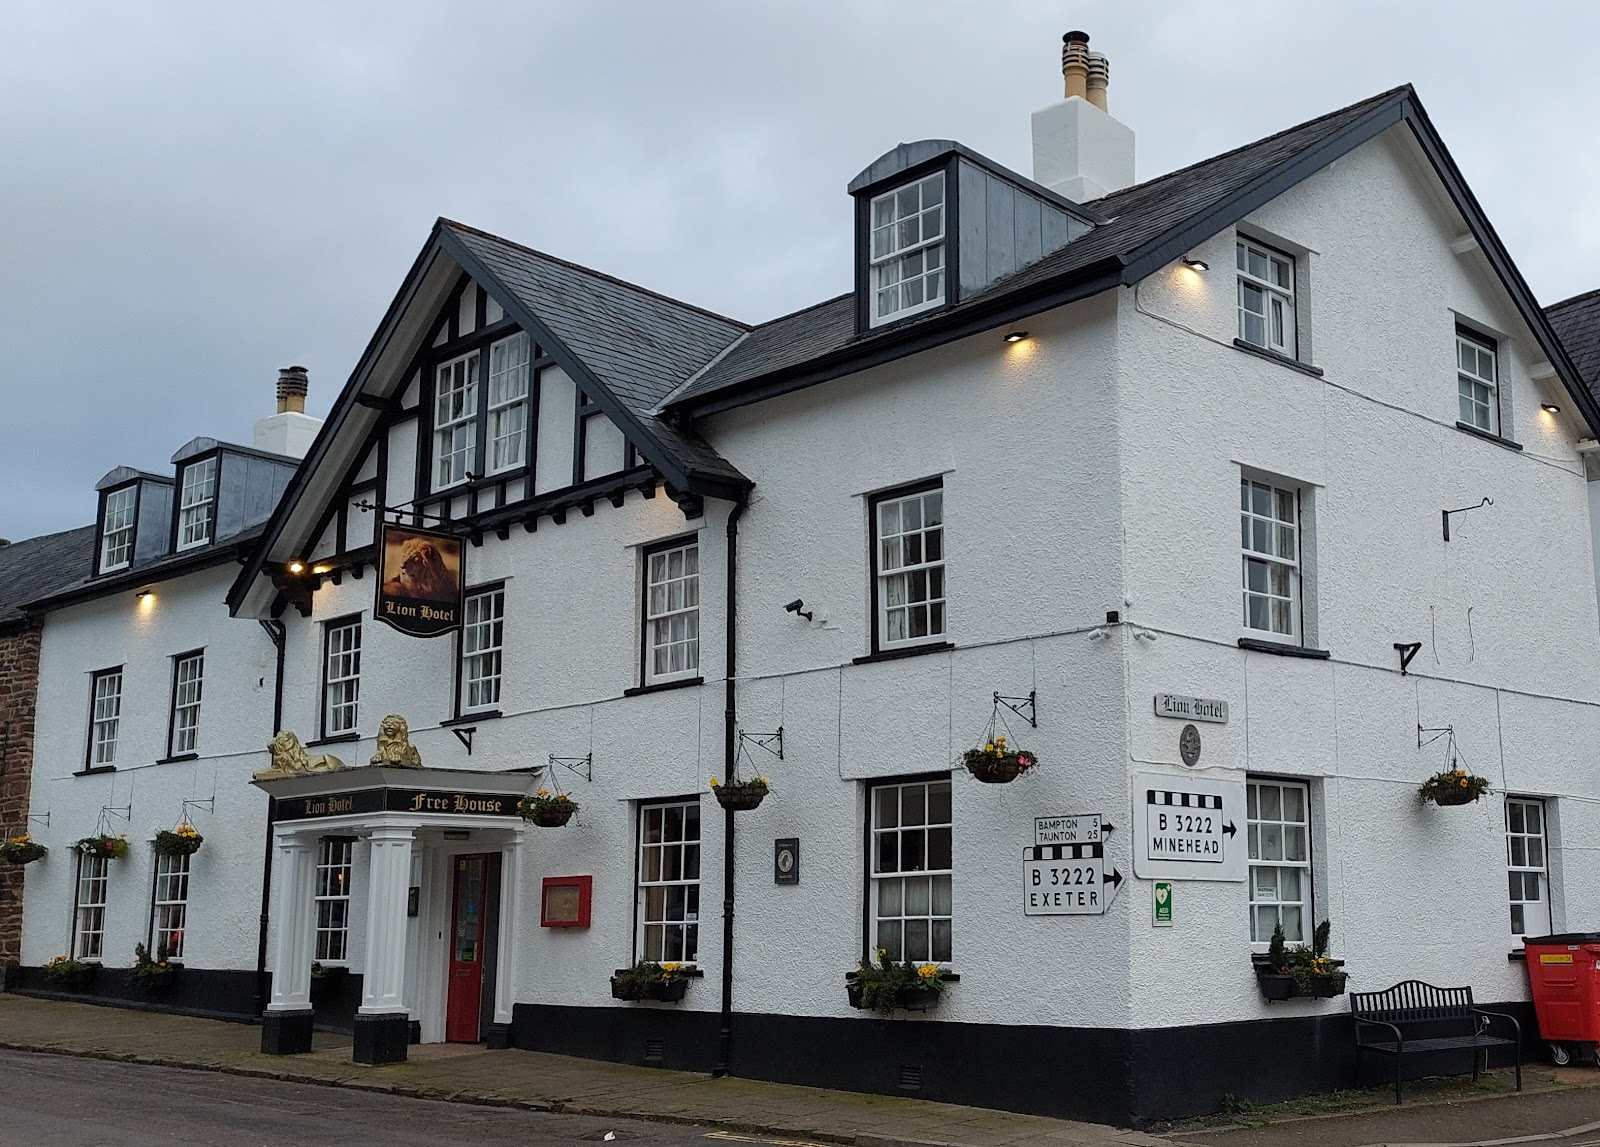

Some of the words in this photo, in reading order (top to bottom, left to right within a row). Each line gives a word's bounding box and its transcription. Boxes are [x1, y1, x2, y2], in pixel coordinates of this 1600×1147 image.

[385, 601, 416, 617] Lion
[420, 605, 454, 621] Hotel
[1192, 698, 1222, 720] Hotel
[305, 799, 325, 815] Lion
[327, 796, 353, 814] Hotel
[409, 793, 448, 811] Free
[453, 794, 502, 813] House
[1039, 820, 1078, 830] BAMPTON
[1093, 818, 1098, 828] 5
[1159, 813, 1167, 830] B
[1175, 815, 1212, 833] 3222
[1039, 831, 1077, 842] TAUNTON
[1087, 830, 1098, 840] 25
[1153, 837, 1218, 854] MINEHEAD
[1032, 869, 1041, 886] B
[1050, 867, 1095, 886] 3222
[1030, 891, 1098, 906] EXETER
